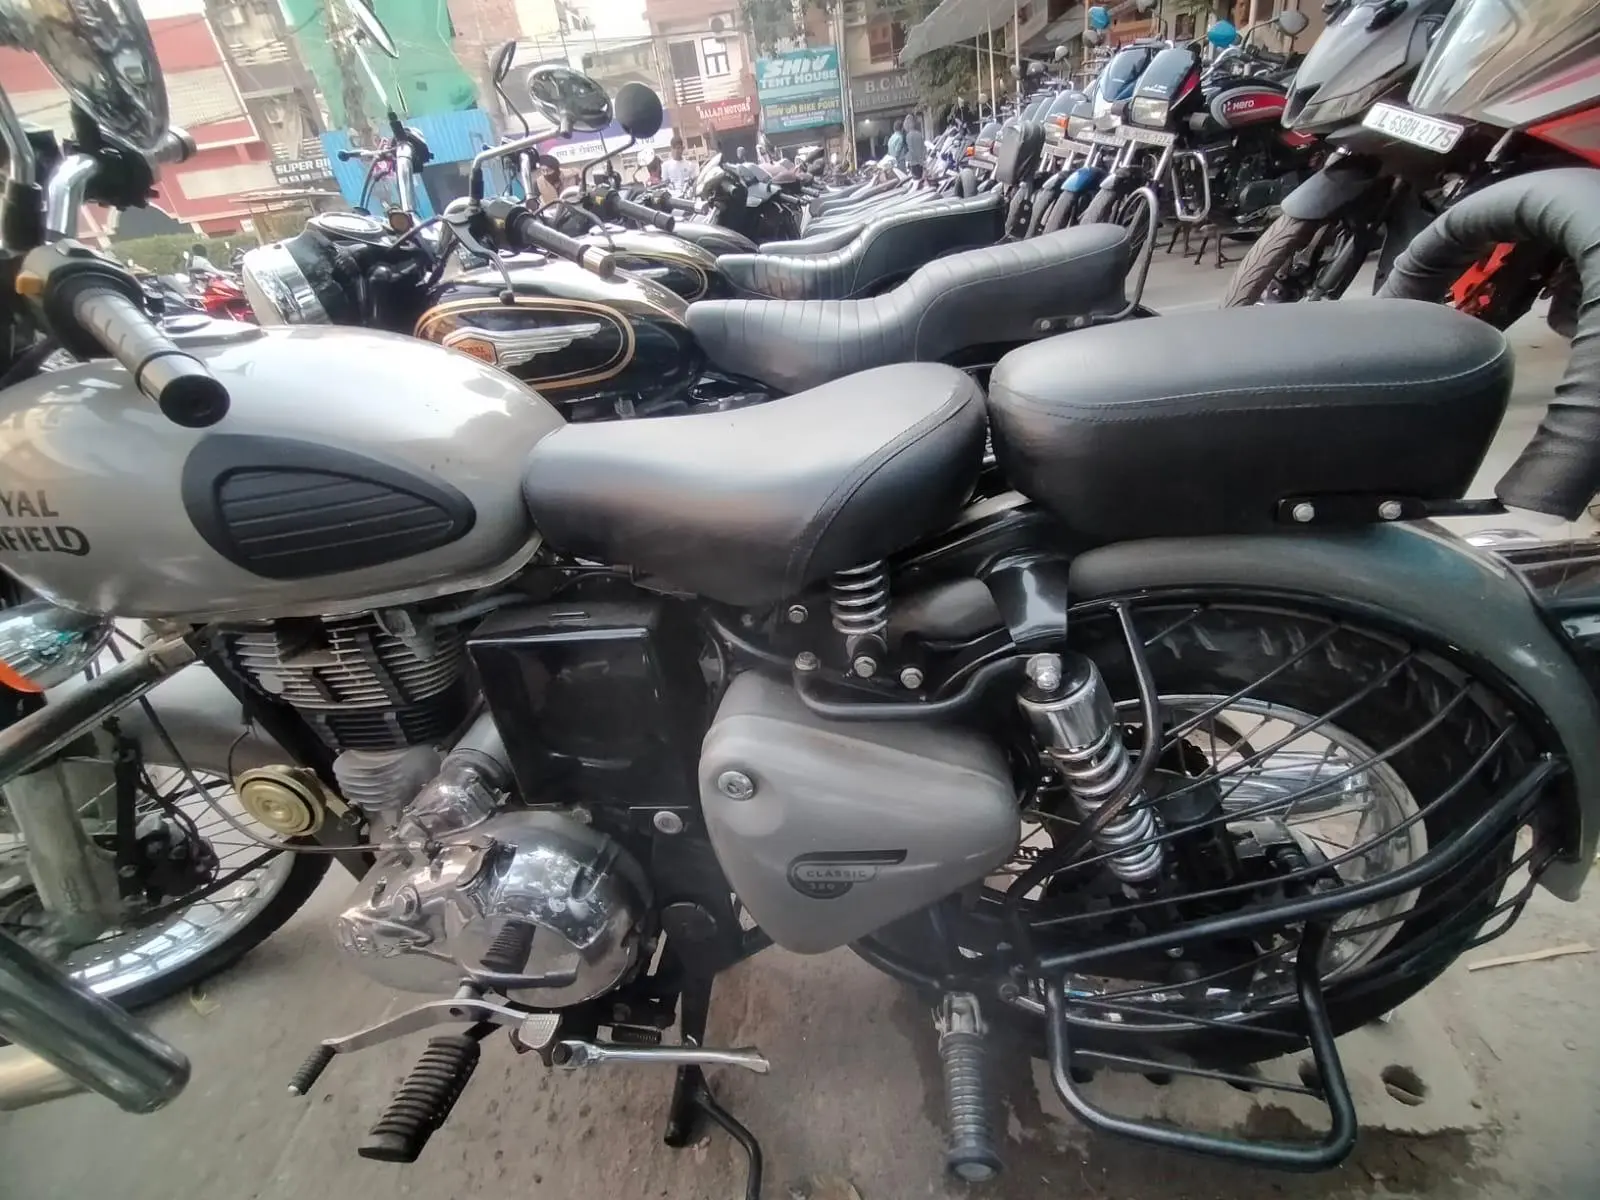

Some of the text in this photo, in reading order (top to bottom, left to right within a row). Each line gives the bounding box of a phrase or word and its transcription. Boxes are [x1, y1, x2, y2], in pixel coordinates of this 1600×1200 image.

[759, 69, 838, 89] TENT HOUSE
[275, 160, 314, 175] SUPER
[805, 869, 867, 878] CLASSIC
